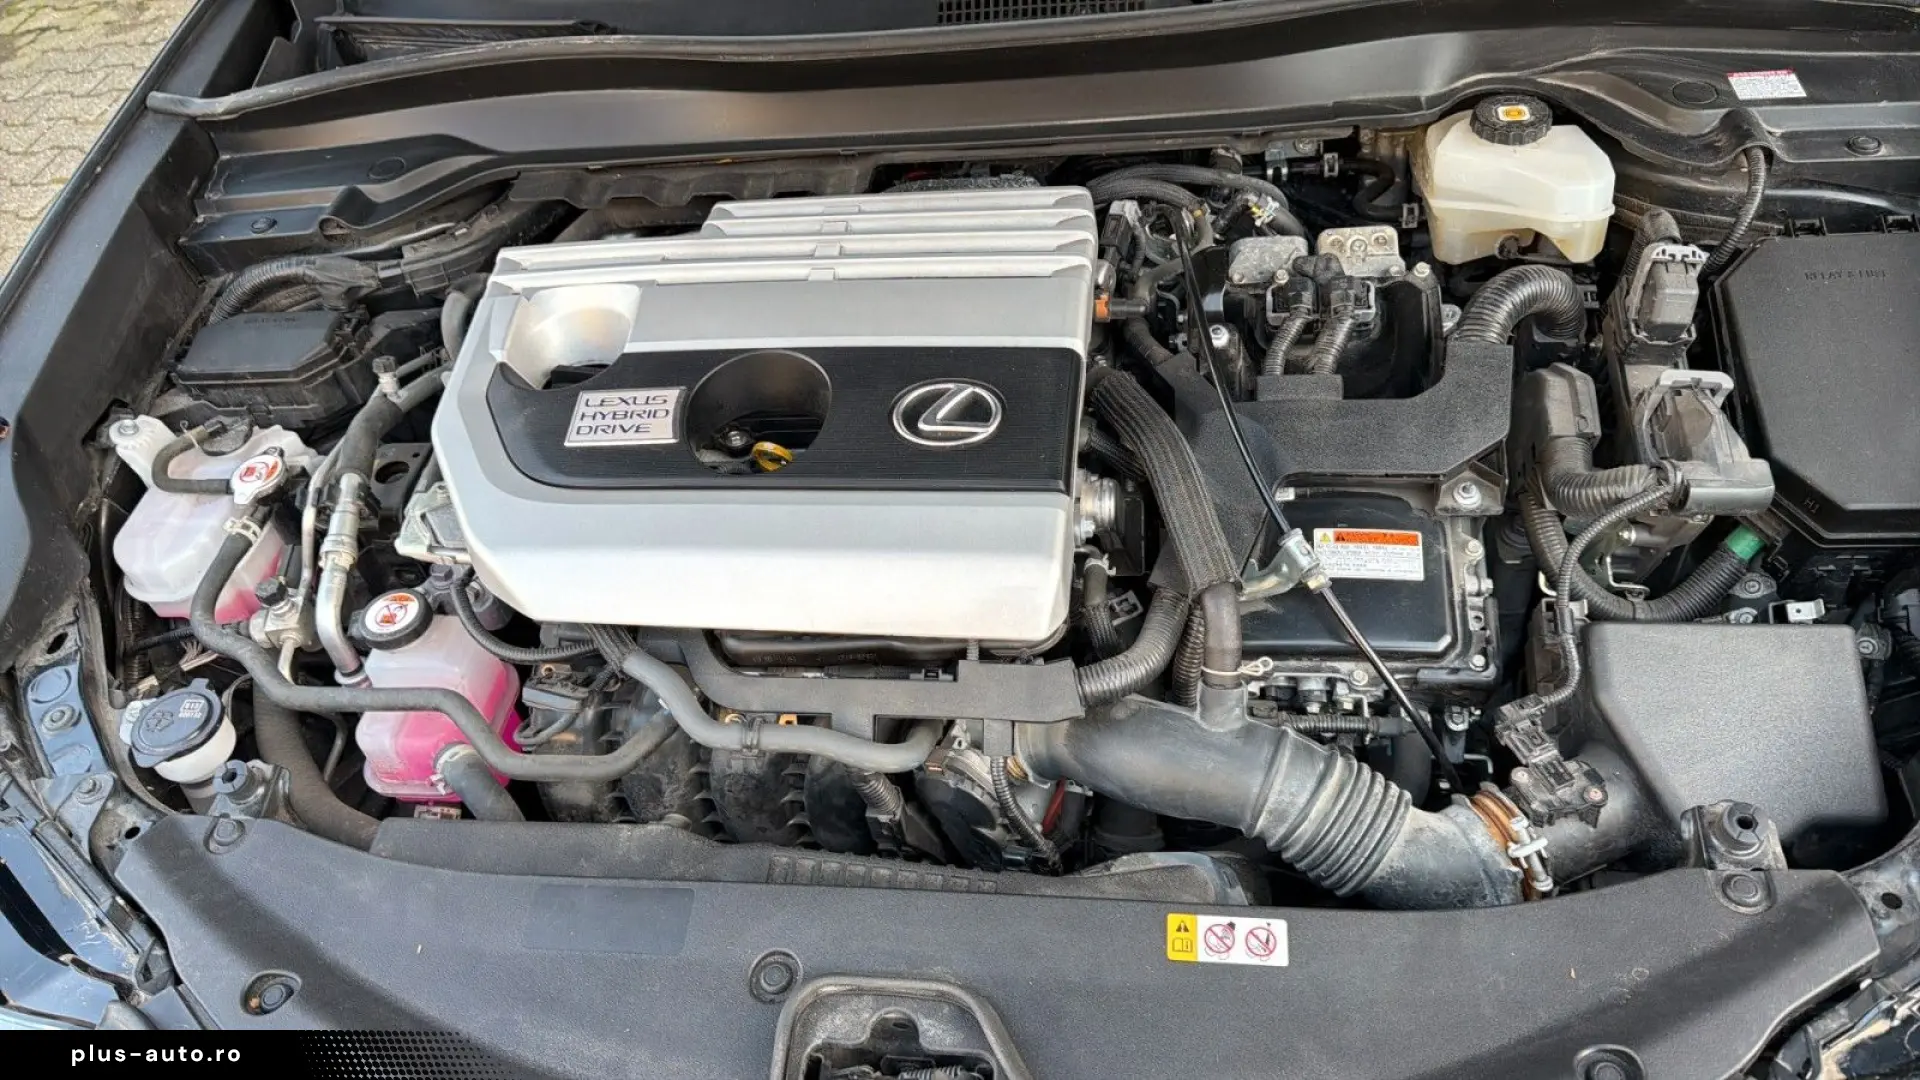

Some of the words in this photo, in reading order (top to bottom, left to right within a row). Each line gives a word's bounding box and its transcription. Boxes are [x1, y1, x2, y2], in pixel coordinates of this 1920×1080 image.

[584, 394, 668, 408] LEXUS
[580, 408, 670, 422] HYBRID
[576, 422, 652, 436] DRIVE
